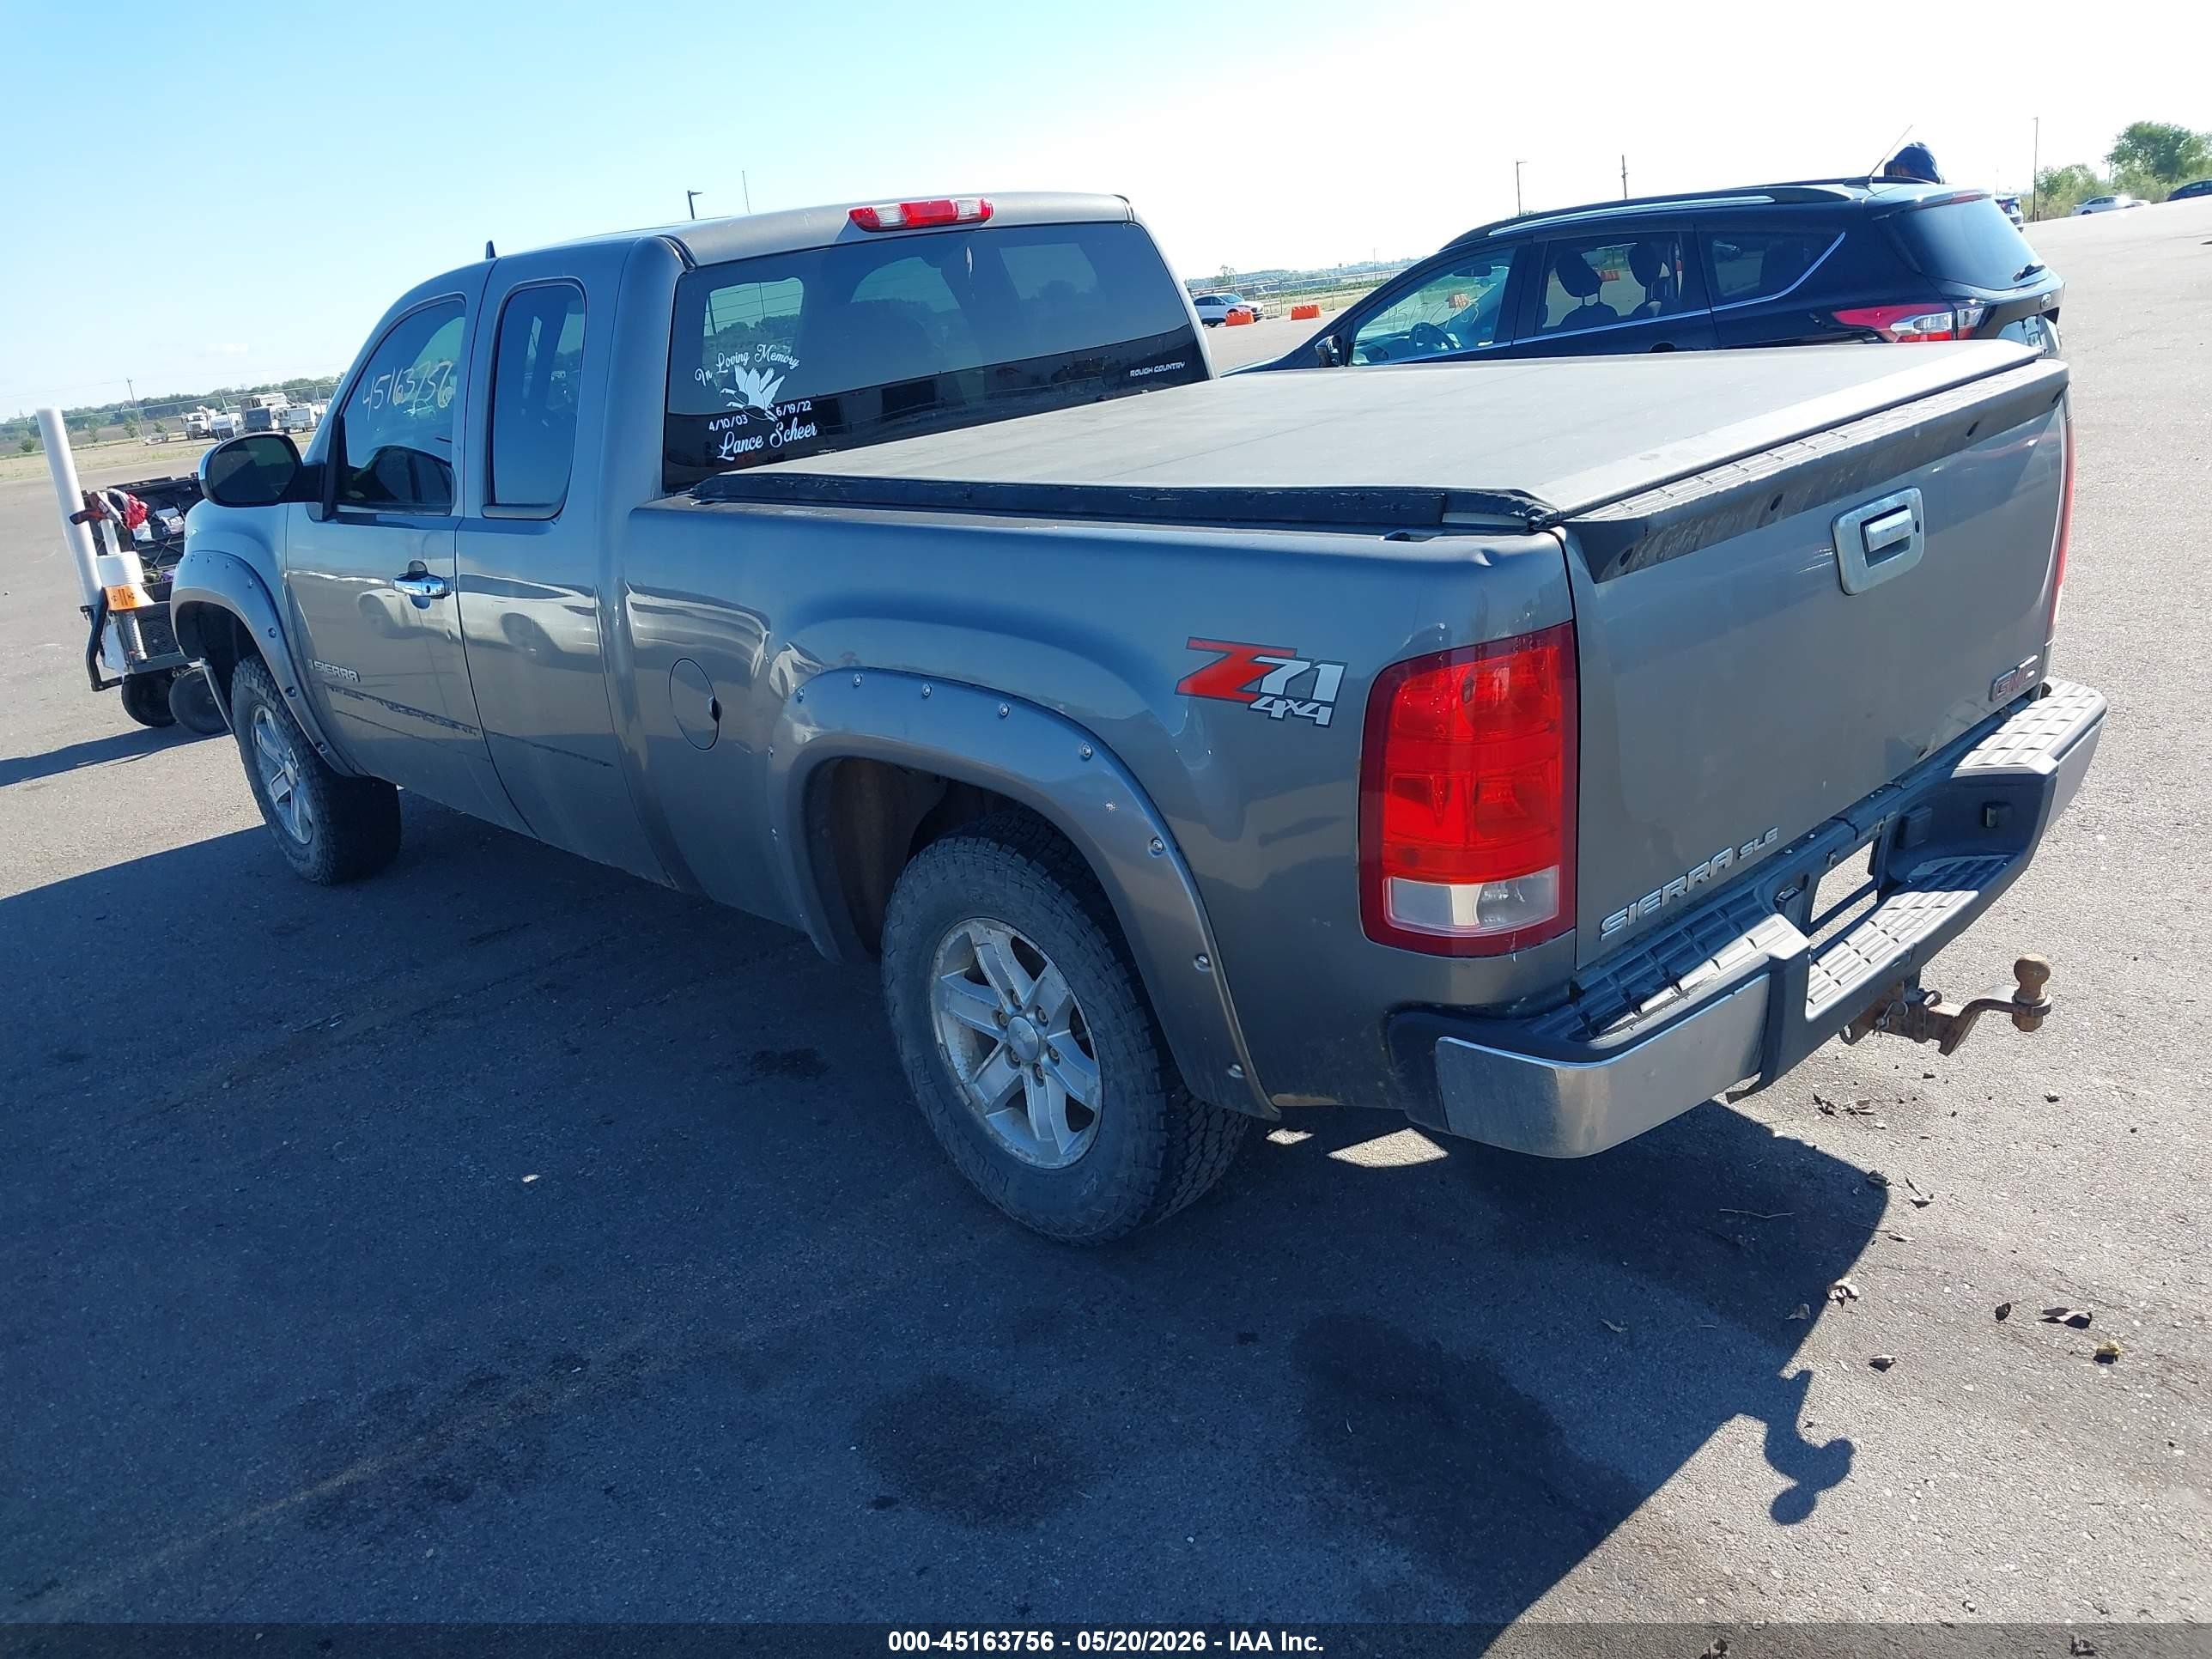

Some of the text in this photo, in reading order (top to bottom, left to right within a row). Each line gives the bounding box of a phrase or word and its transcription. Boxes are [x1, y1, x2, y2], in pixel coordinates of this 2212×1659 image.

[695, 343, 800, 386] In Loving Memory
[1130, 362, 1185, 377] ROUGH COUNTRY
[362, 361, 454, 422] 45163756
[708, 400, 812, 432] 4/10/03 6/19/22
[717, 417, 817, 460] Lance Scheer
[313, 660, 360, 683] SIERRA
[1175, 636, 1347, 702] Z71
[1600, 827, 1778, 941] SIERRA SLE
